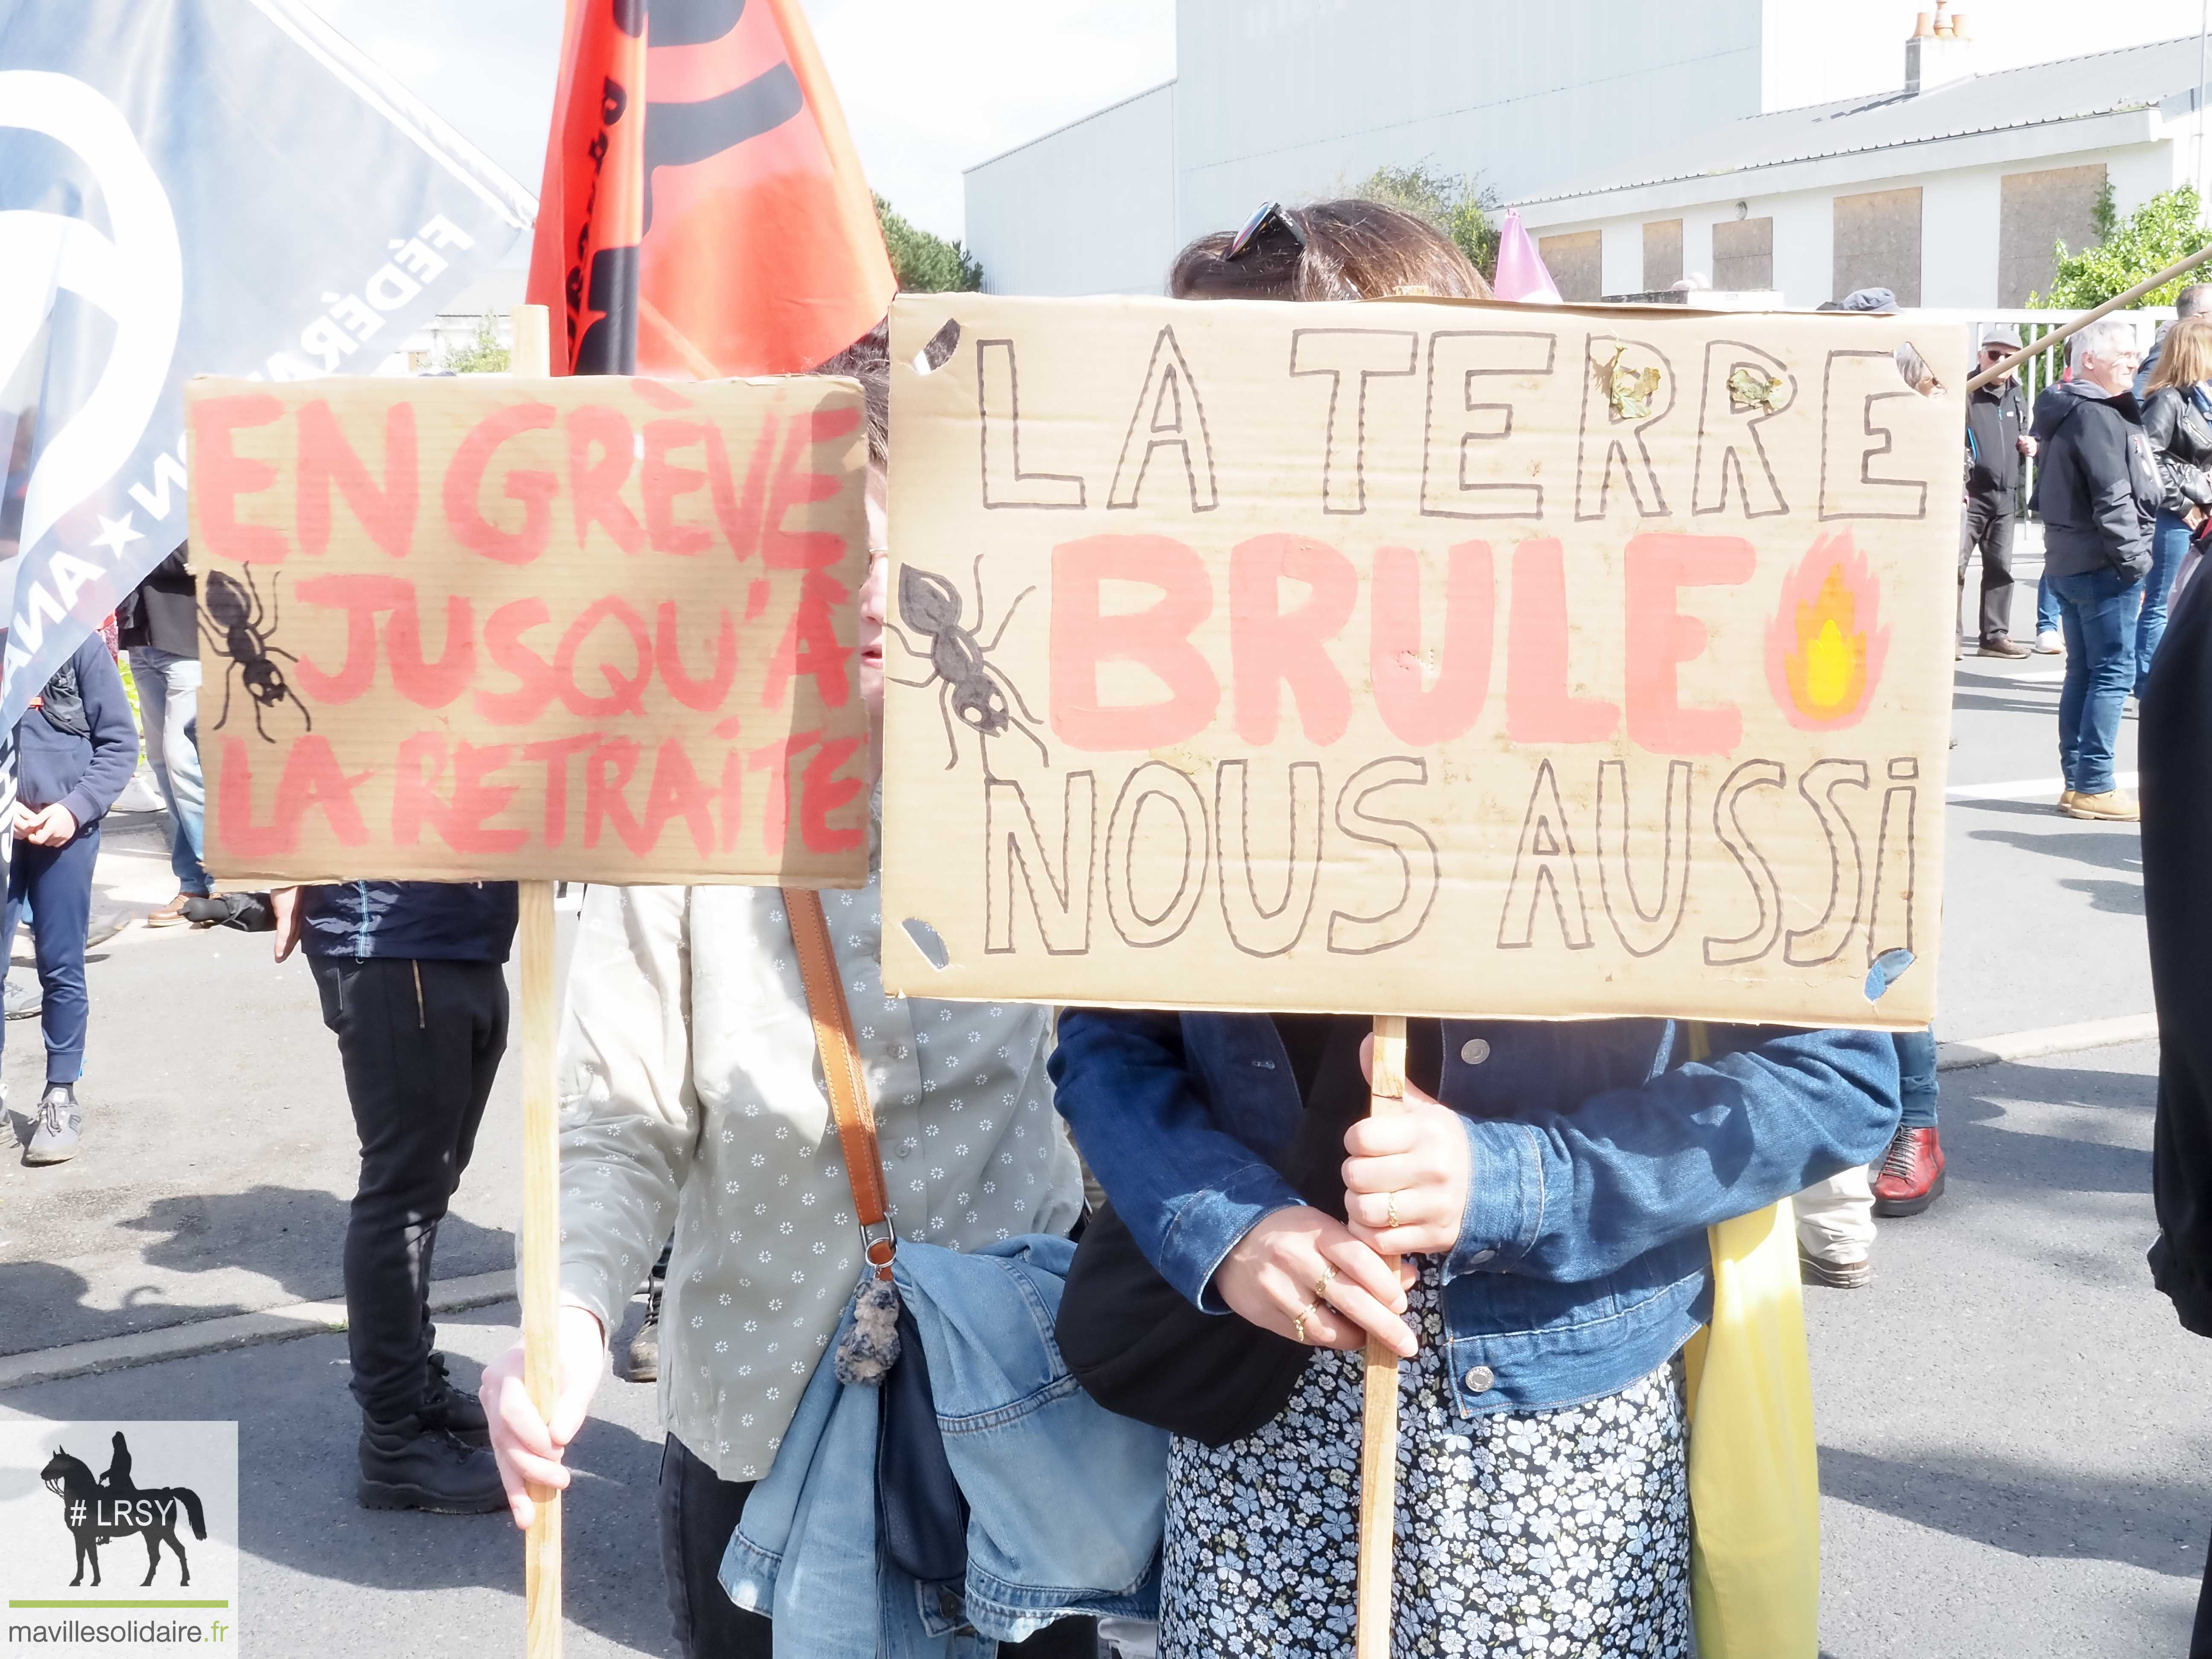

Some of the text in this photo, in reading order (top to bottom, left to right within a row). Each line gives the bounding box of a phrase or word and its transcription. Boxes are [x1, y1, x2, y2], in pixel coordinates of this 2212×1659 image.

[191, 378, 862, 569] EN GRÈVE
[977, 324, 1928, 522] LA TERRE
[1050, 533, 1757, 756] BRULE
[218, 733, 378, 859] LA
[984, 756, 1441, 959] NOUS
